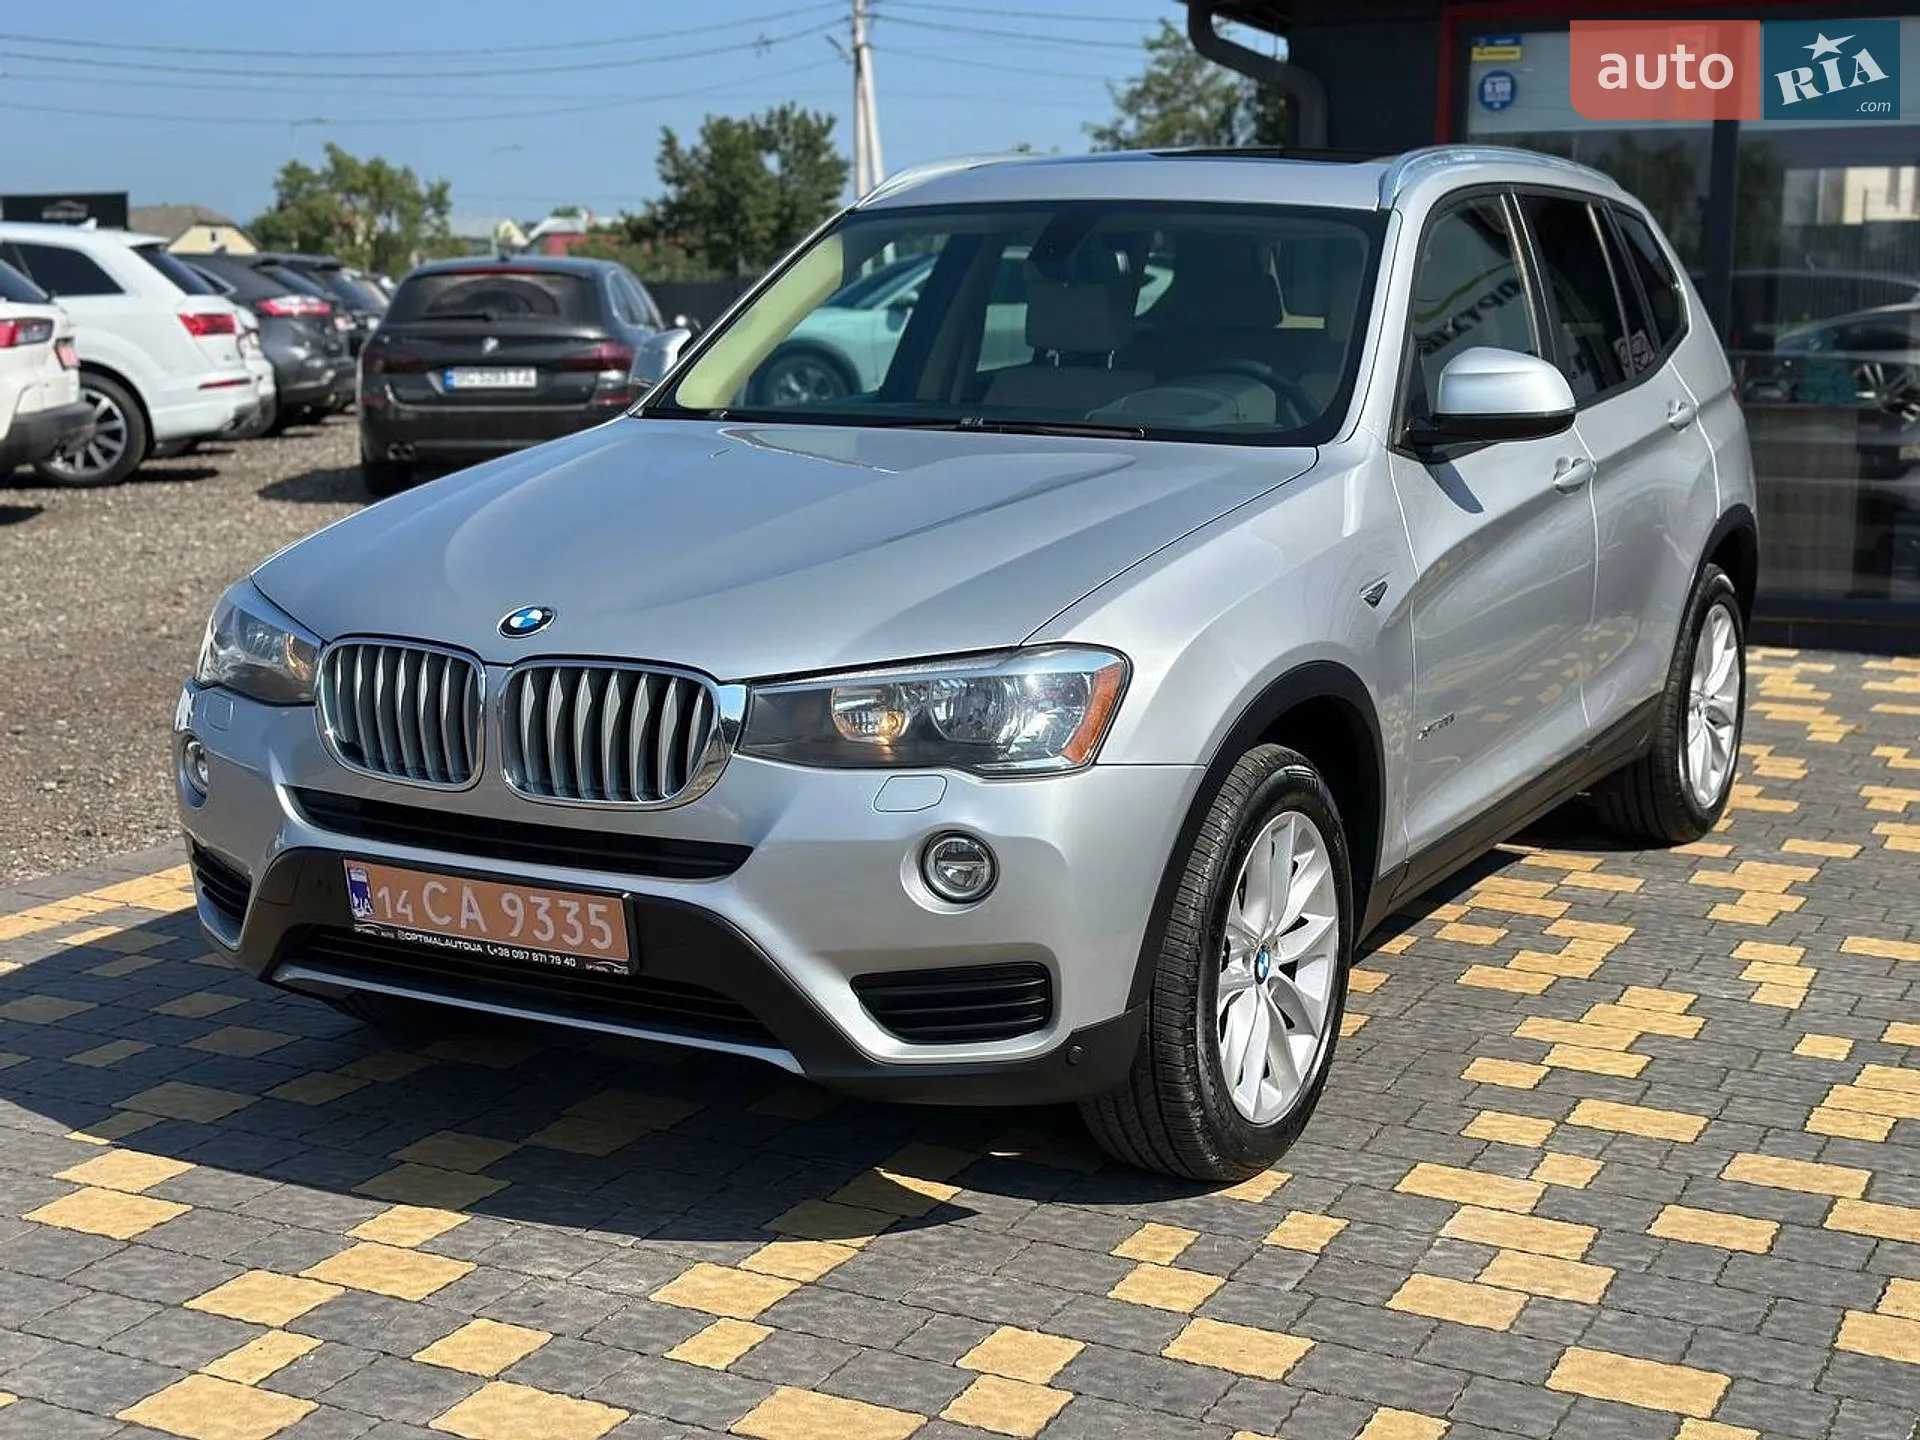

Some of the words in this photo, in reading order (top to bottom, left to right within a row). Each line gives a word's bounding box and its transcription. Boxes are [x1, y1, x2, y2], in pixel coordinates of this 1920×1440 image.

[377, 886, 414, 923] 14
[423, 881, 488, 932] CA
[500, 892, 613, 950] 9335
